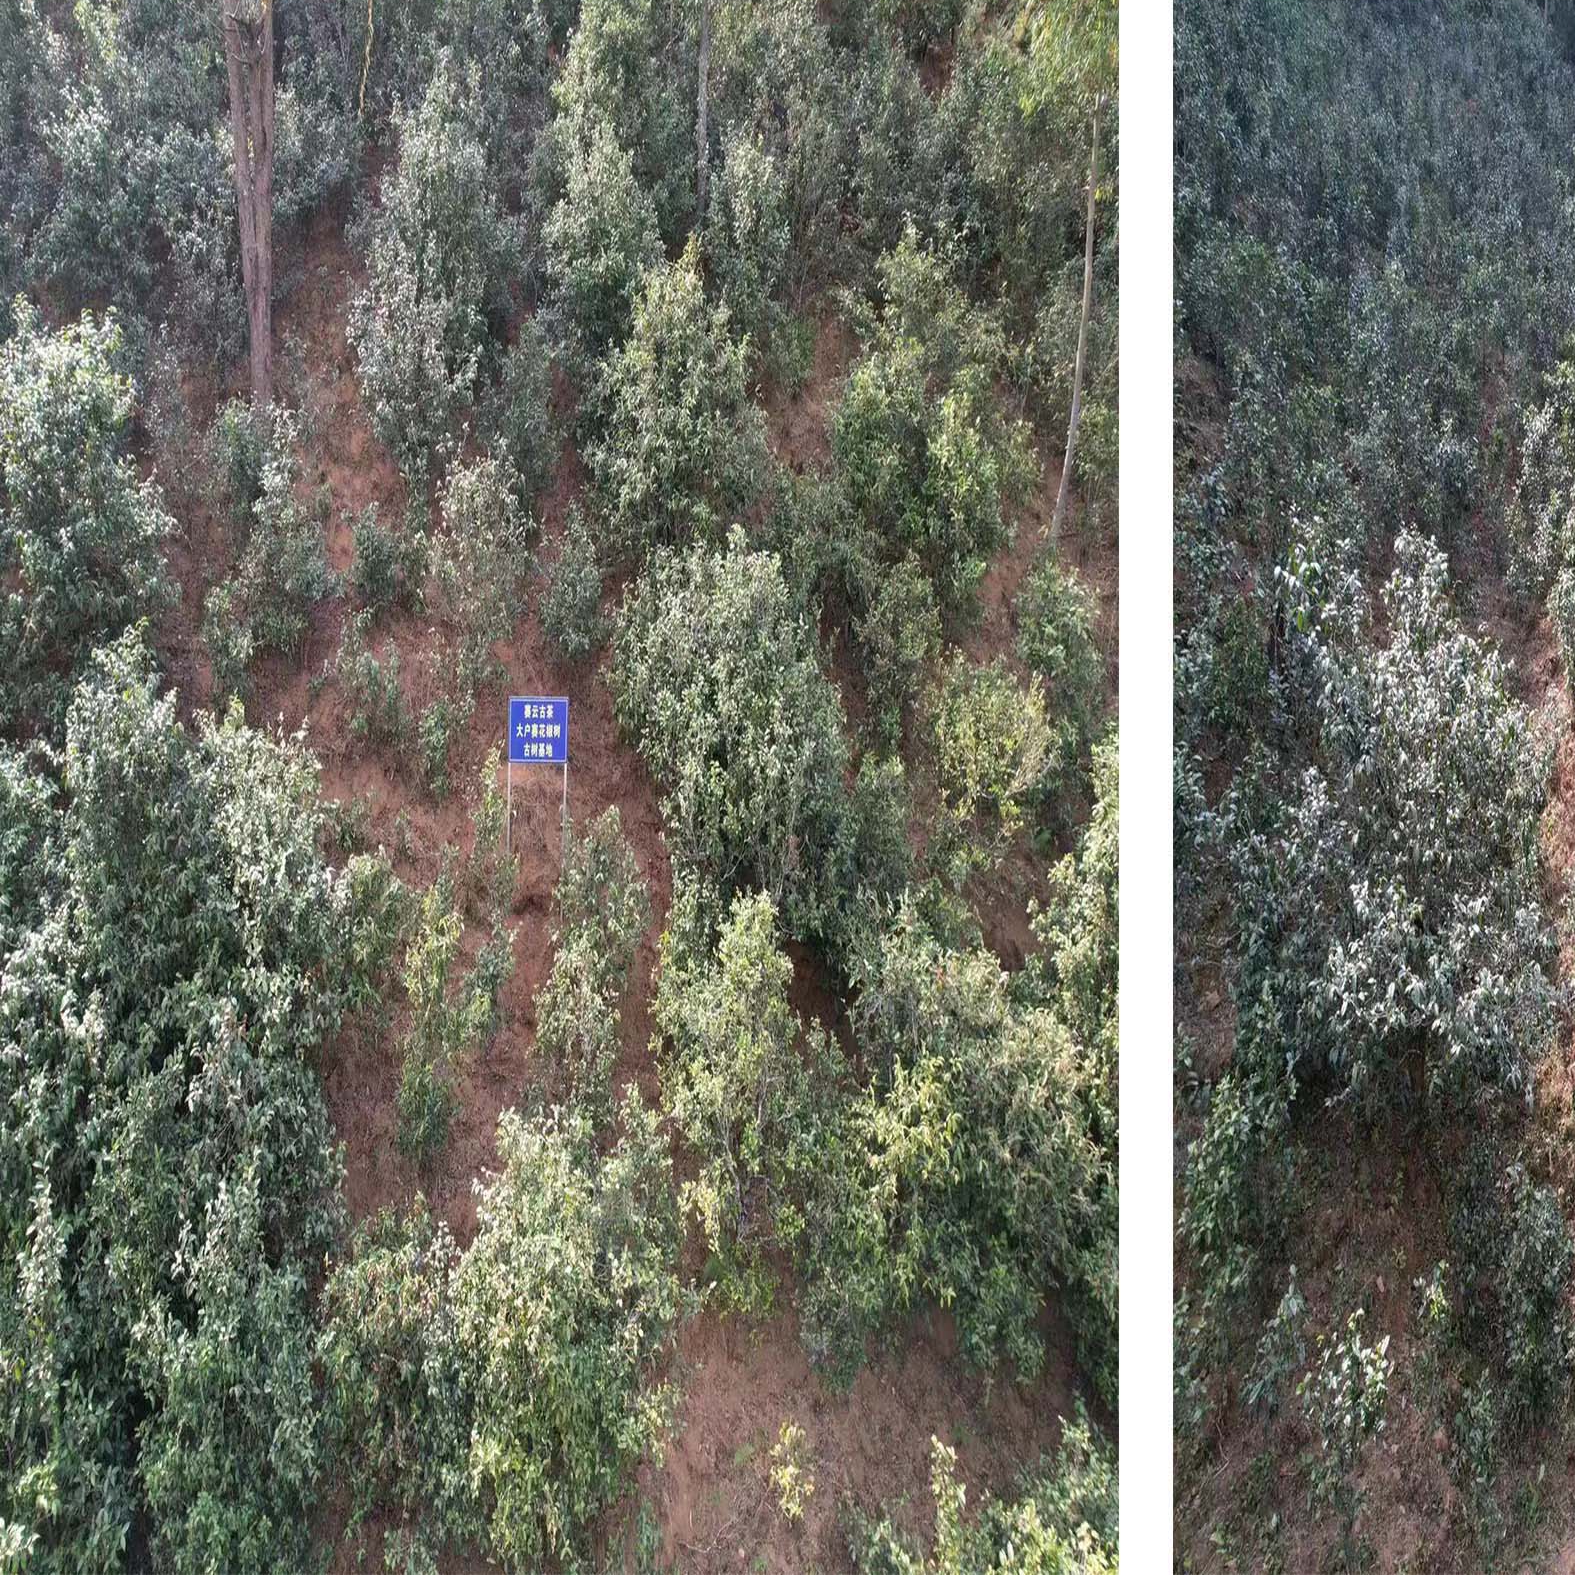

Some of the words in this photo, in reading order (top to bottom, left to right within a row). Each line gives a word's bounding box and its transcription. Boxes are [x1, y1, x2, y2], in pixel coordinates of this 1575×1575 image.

[524, 704, 554, 719] 赛云古茶
[523, 742, 553, 758] 古树基地
